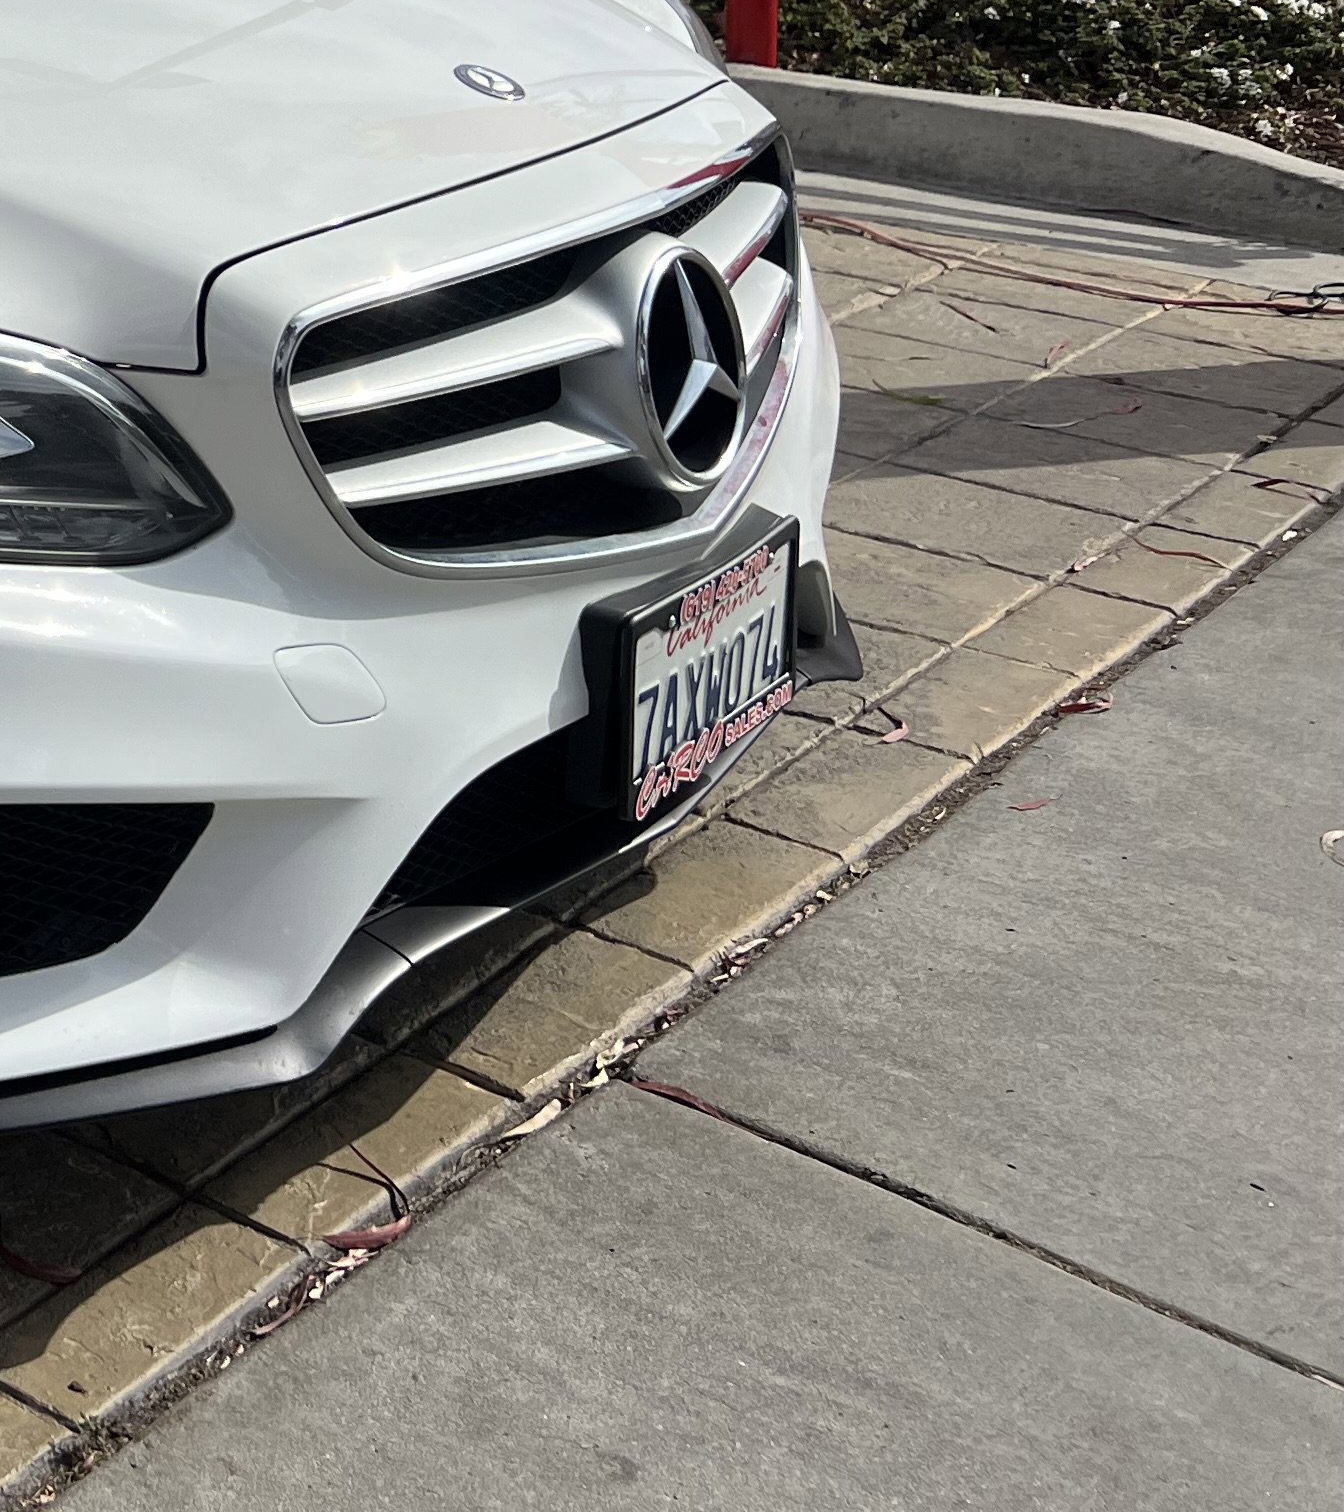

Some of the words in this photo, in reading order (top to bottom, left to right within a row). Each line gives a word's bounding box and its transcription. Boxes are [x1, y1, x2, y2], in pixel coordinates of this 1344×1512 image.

[666, 576, 768, 656] California
[679, 579, 717, 625] (619)
[636, 601, 782, 778] 7AXW074
[724, 679, 793, 747] SALES.COM
